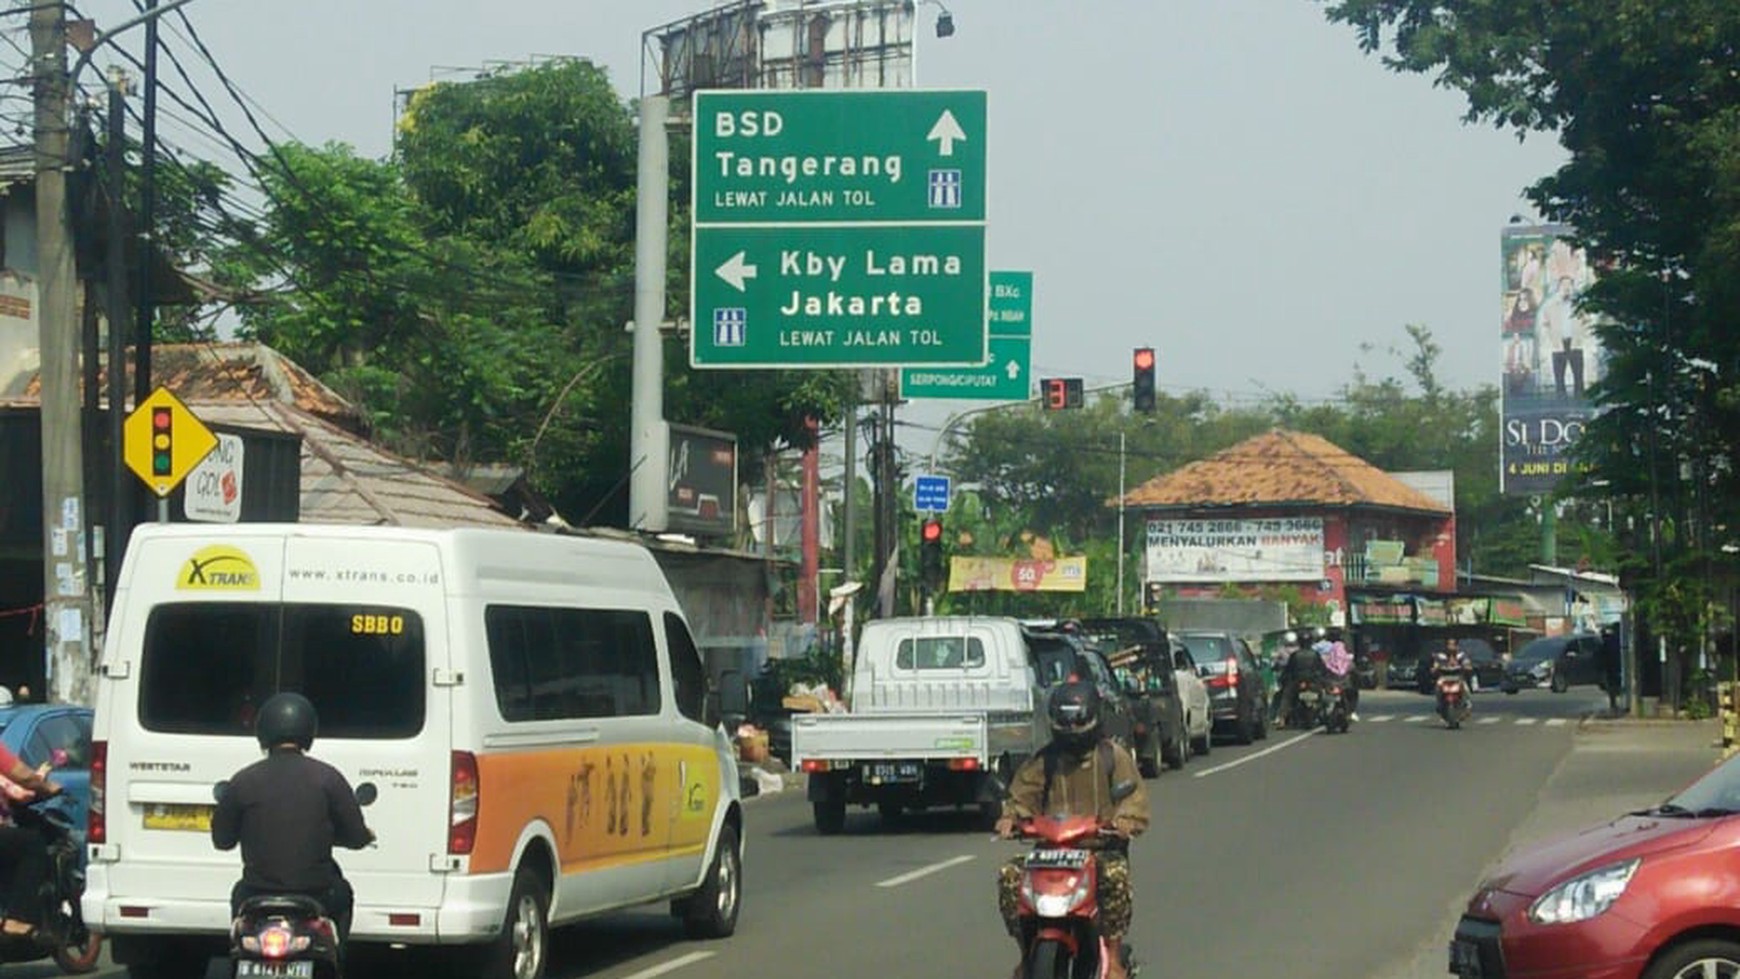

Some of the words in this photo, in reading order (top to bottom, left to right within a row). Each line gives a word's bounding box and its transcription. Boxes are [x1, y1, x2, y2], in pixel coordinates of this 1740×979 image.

[715, 111, 784, 138] BSD
[715, 151, 902, 184] Tangerang
[715, 191, 767, 207] LEWAT
[776, 191, 834, 206] JALAN
[843, 190, 876, 206] TOL
[780, 250, 846, 282] Kby
[866, 250, 962, 276] Lama
[780, 290, 923, 316] Jakarta
[780, 331, 834, 346] LEWAT
[843, 331, 901, 346] JALAN
[910, 330, 943, 346] TOL
[1508, 463, 1517, 475] 4
[1520, 462, 1551, 475] JUNI
[1149, 522, 1172, 535] 021
[1149, 535, 1257, 548] MENYALURKAN
